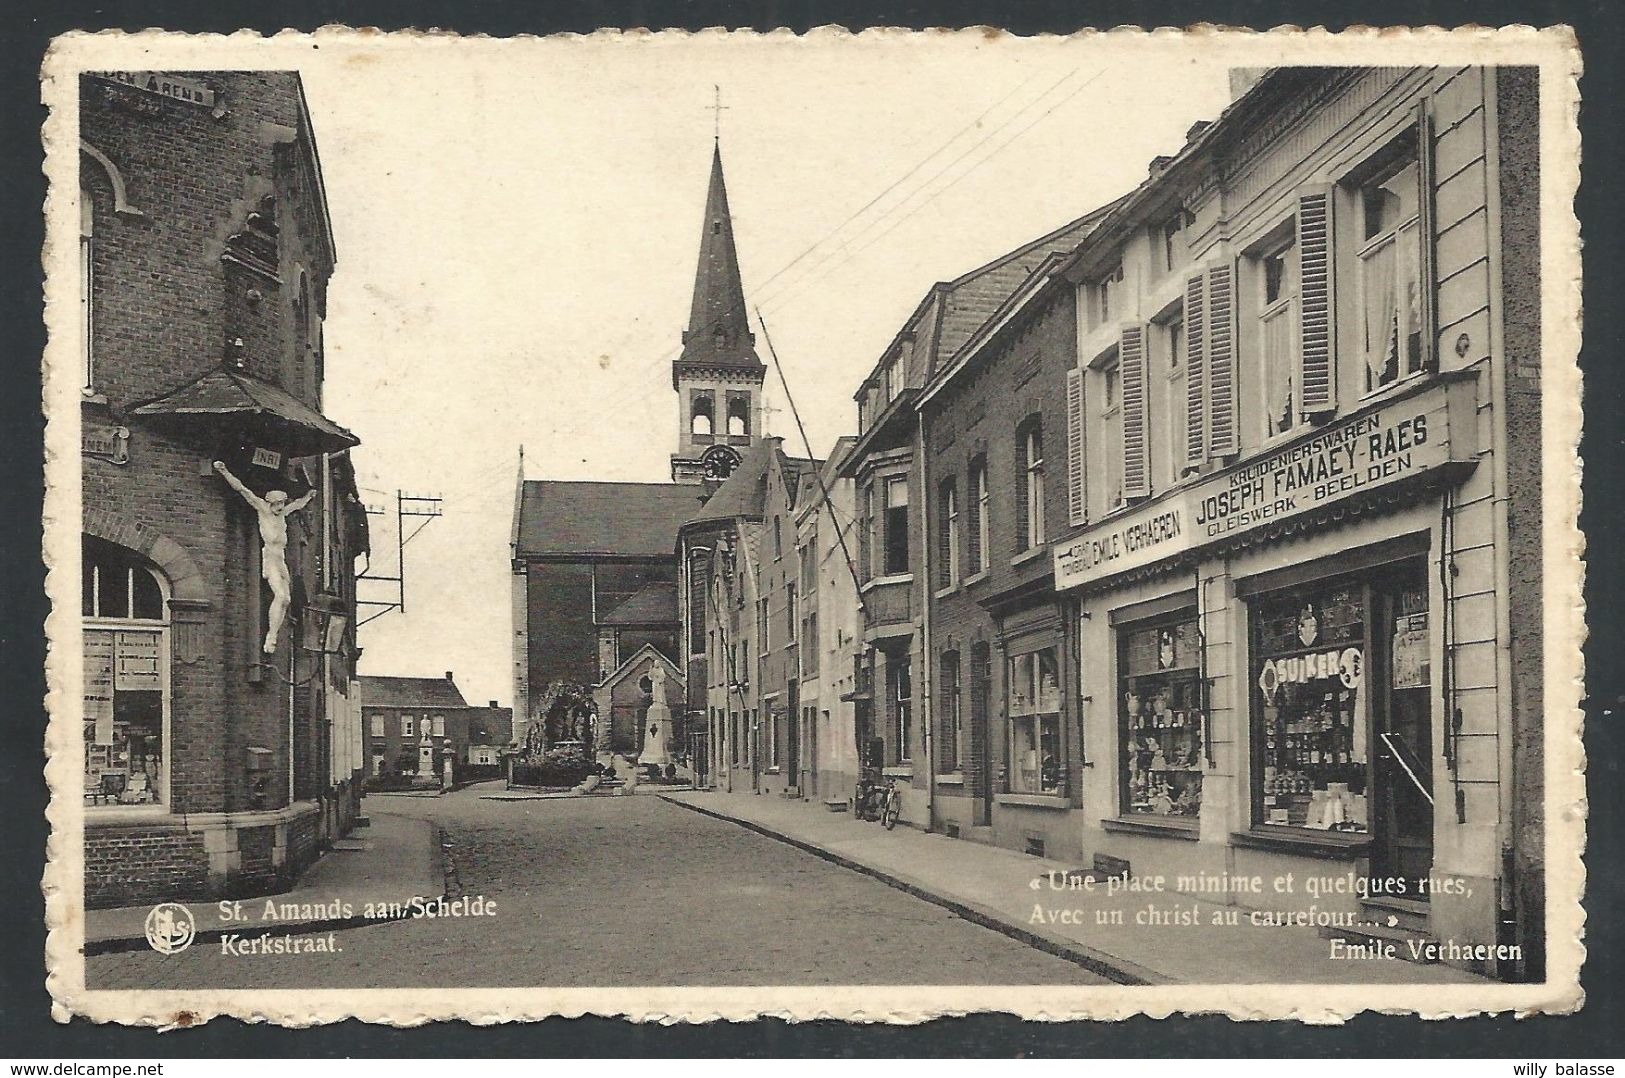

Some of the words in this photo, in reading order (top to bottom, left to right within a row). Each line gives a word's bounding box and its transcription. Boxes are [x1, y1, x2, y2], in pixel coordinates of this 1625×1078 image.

[1230, 413, 1381, 487] KRUIDENIERSWAREN
[1196, 478, 1264, 525] JOSEPH
[1207, 494, 1297, 537] GLEISWERK
[1314, 453, 1412, 501] BEELDEN
[1093, 533, 1120, 565] EMILE
[1122, 510, 1181, 555] VERHAEREN
[1276, 650, 1340, 684] SUIKER
